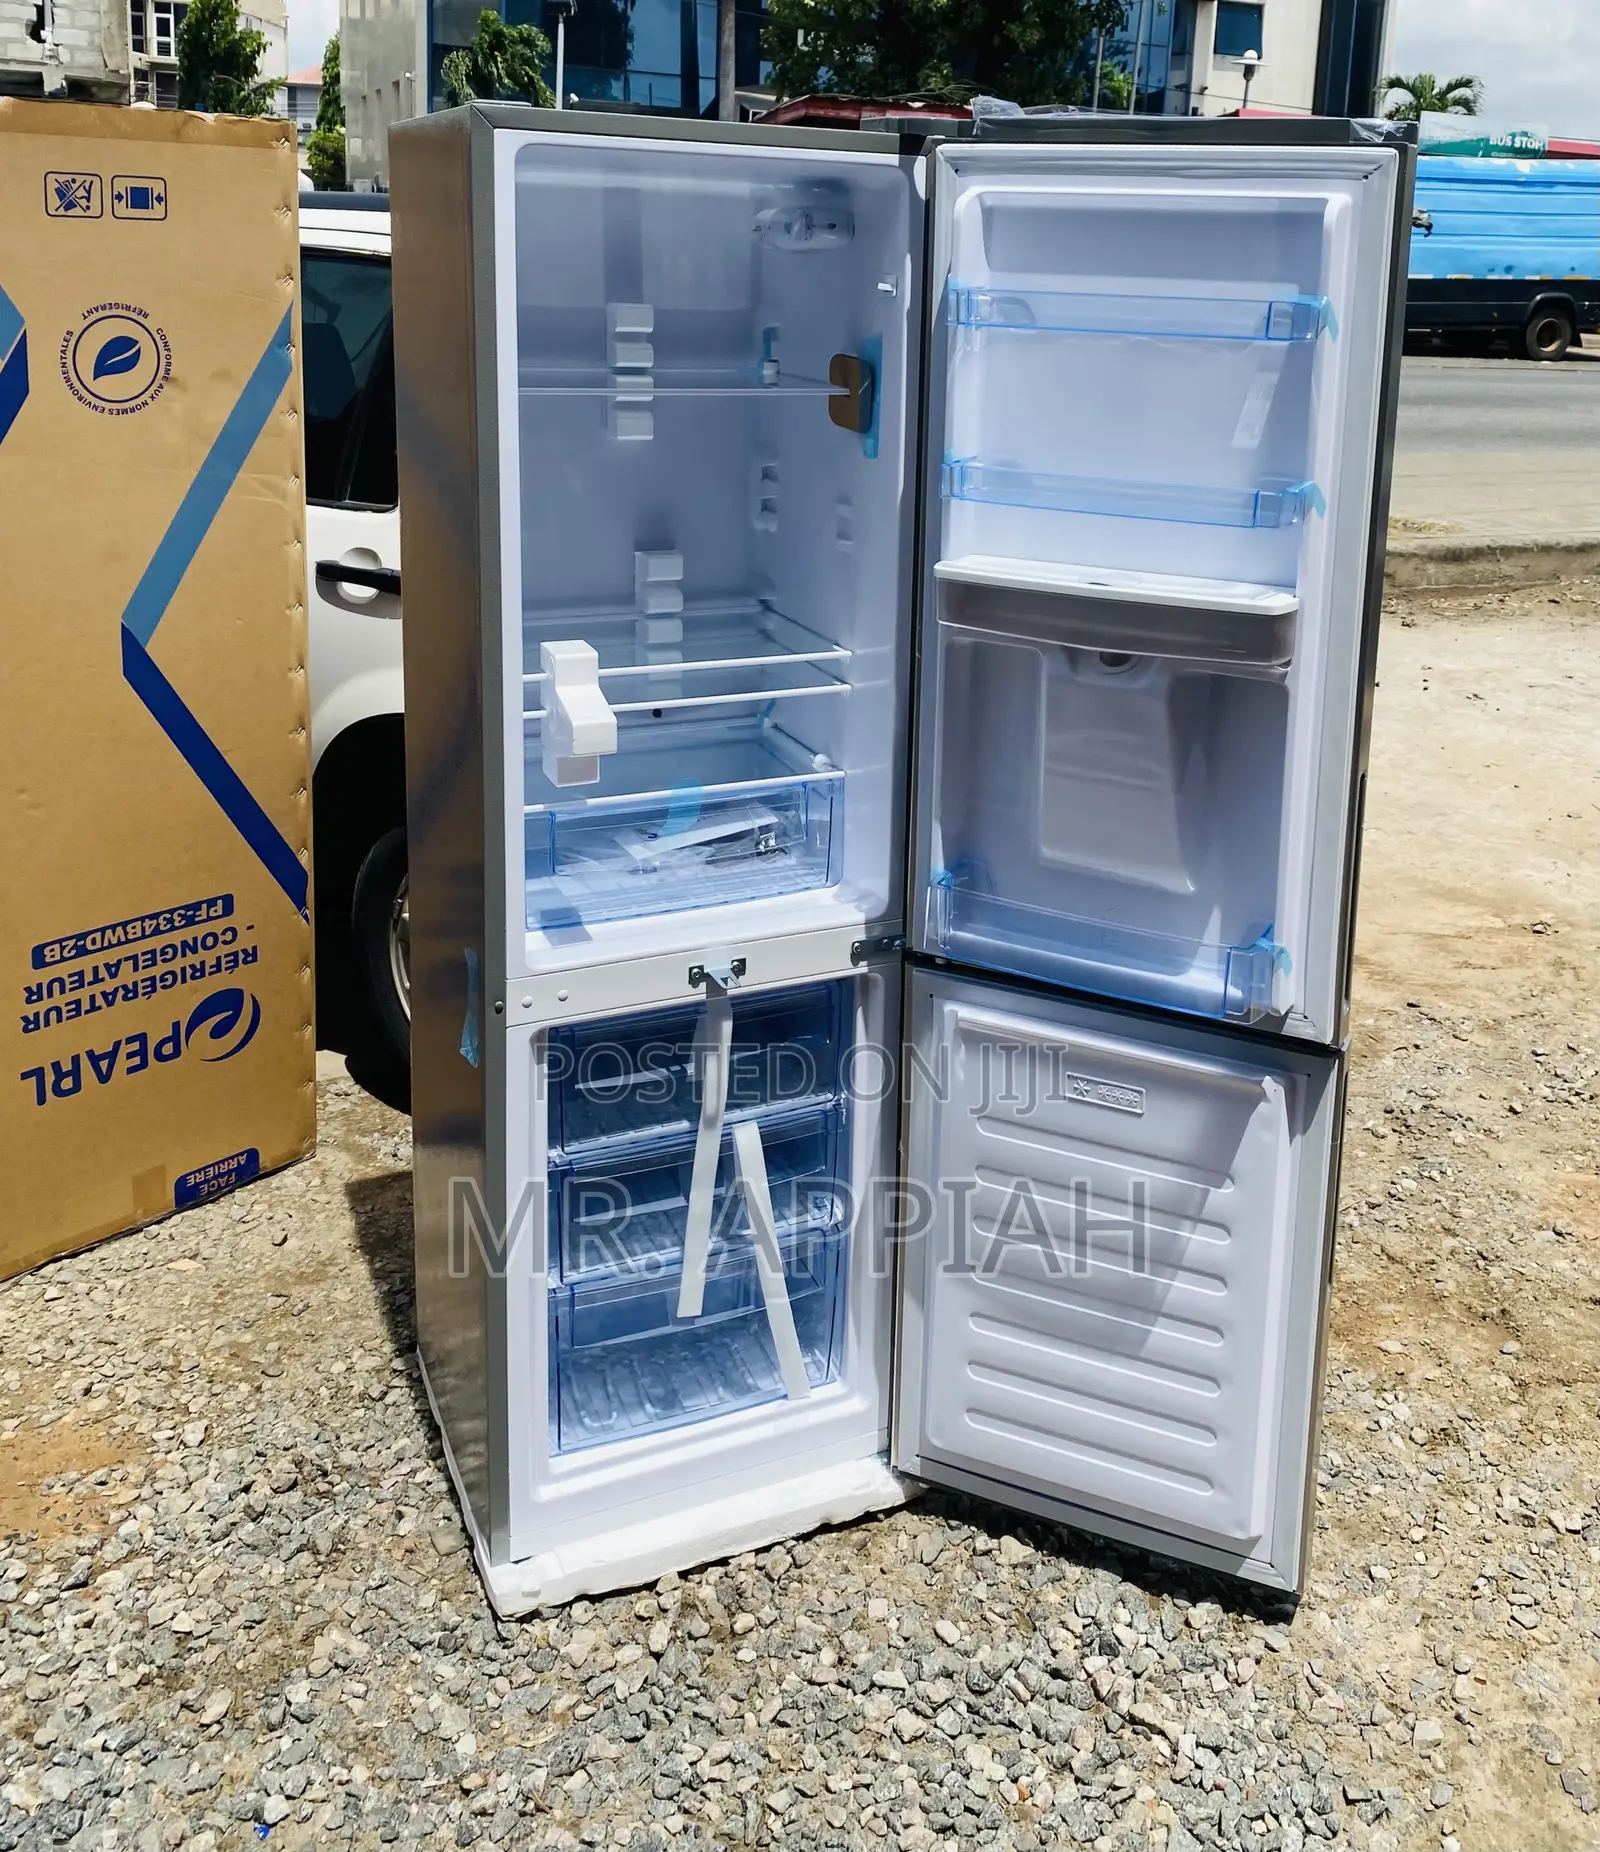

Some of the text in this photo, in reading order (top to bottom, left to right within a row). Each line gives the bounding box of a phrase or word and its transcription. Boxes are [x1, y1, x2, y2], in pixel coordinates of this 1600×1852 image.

[1489, 135, 1544, 150] BUS STOP
[156, 327, 172, 382] CONFORME
[108, 400, 149, 416] NORMES
[148, 383, 164, 401] AUX
[43, 898, 223, 962] PF-334BWD-2B
[20, 945, 259, 1034] RÉFRIGÉRATEUR
[23, 926, 238, 1005] CONGELATEUR
[20, 1019, 182, 1106] PEARL
[199, 1172, 236, 1196] FACE
